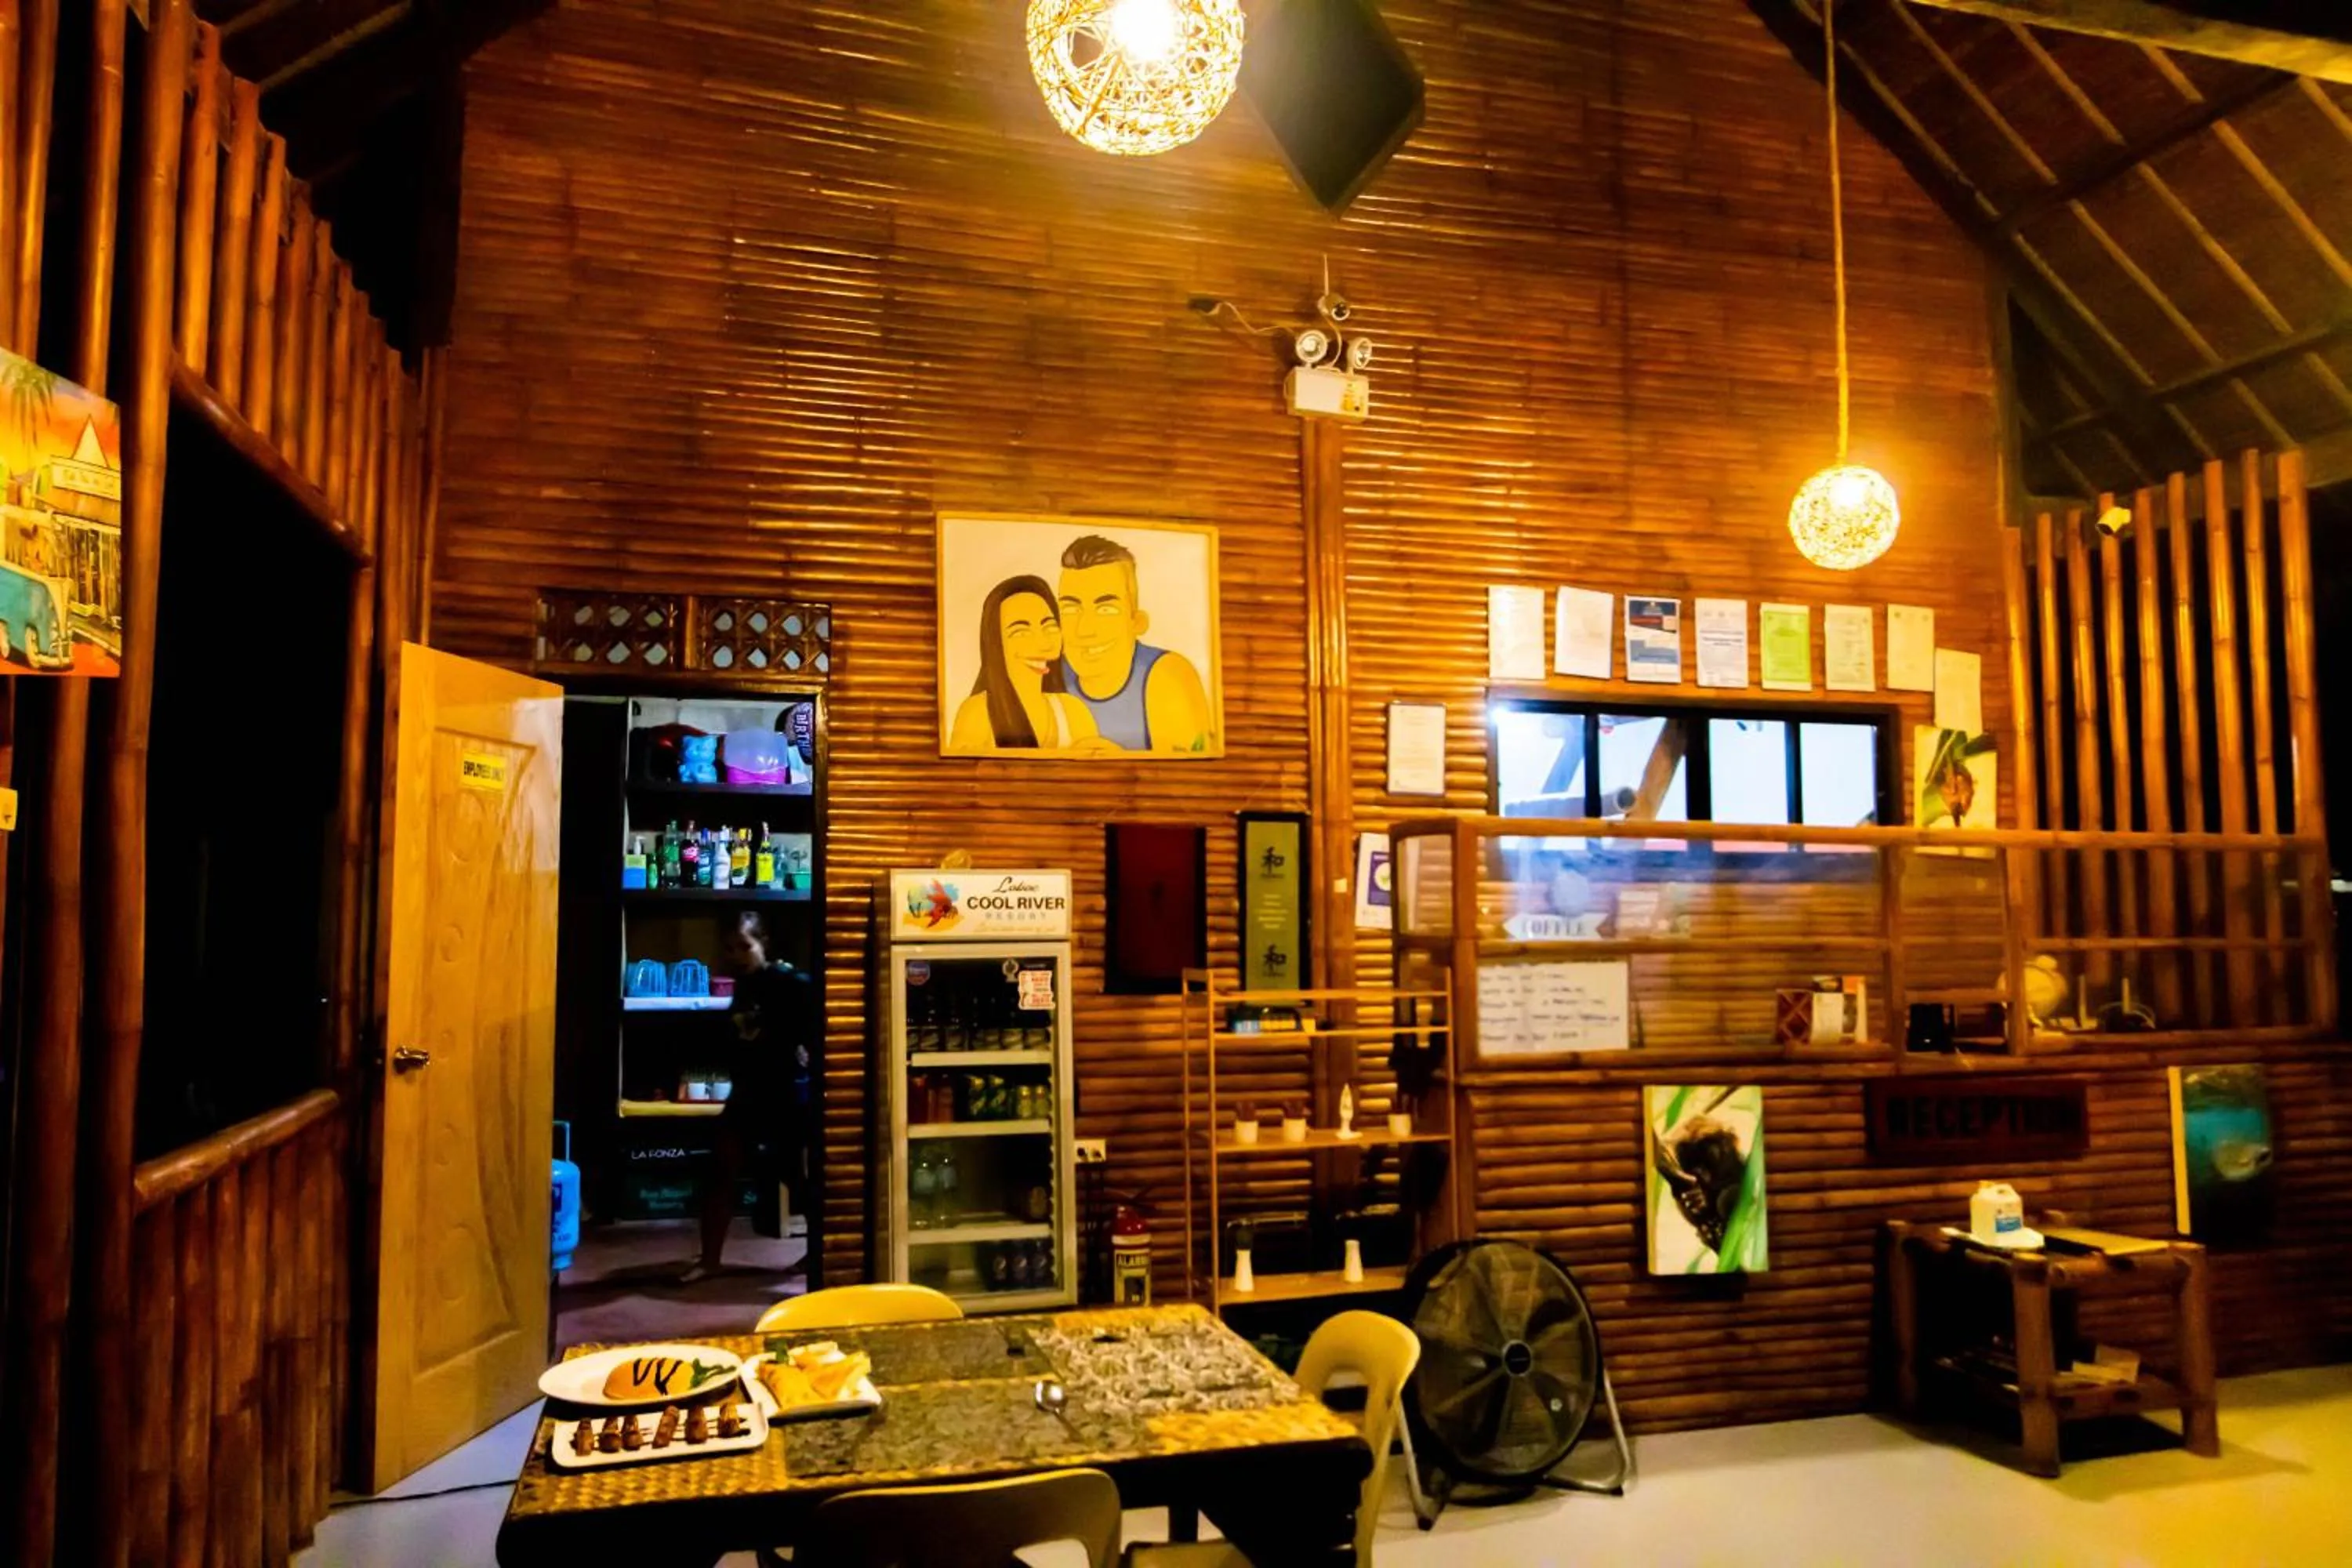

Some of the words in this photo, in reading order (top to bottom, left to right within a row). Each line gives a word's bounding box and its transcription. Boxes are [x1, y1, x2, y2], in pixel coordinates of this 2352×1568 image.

[967, 896, 1014, 910] COOL
[1017, 896, 1065, 910] RIVER
[985, 911, 1047, 920] RESORT
[1522, 918, 1586, 936] COFFEE
[1888, 1096, 2081, 1138] RECEPT
